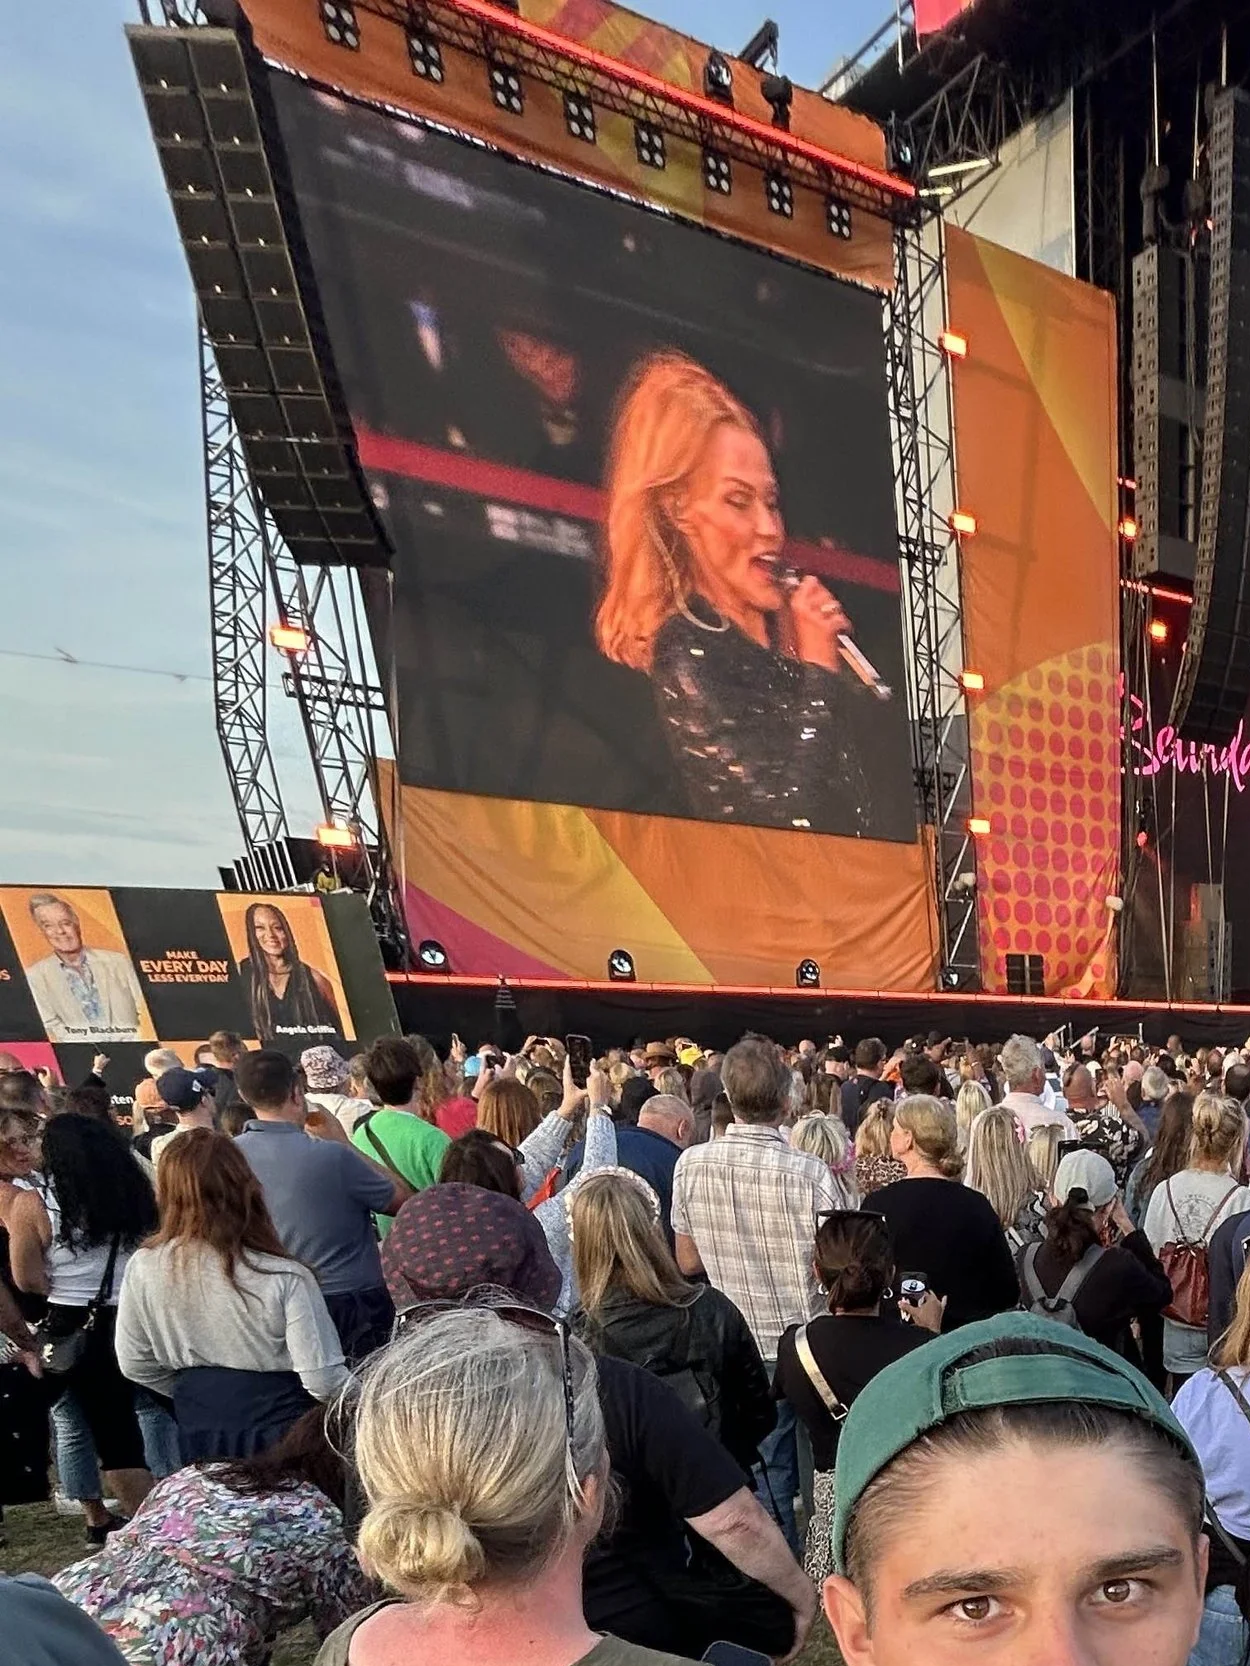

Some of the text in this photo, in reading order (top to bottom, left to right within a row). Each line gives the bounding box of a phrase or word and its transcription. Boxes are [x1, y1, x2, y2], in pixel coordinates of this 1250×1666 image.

[165, 950, 199, 960] MAKE
[140, 960, 229, 974] EVERY DAY
[148, 973, 229, 984] LESS EVERYDAY
[65, 1026, 138, 1036] Tony Blackburn
[275, 1024, 307, 1036] Angela
